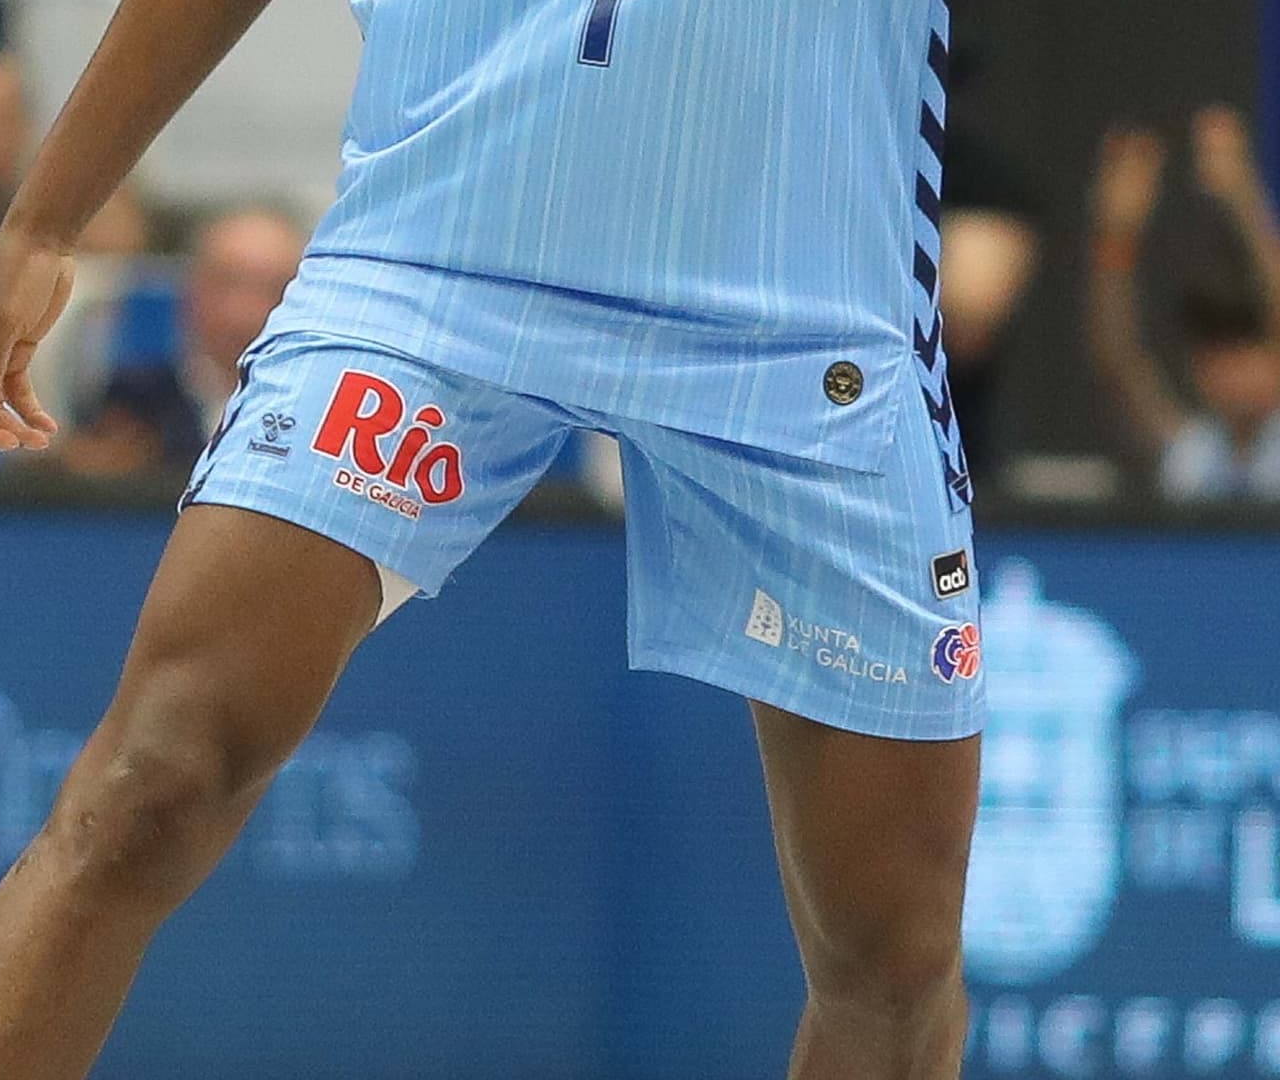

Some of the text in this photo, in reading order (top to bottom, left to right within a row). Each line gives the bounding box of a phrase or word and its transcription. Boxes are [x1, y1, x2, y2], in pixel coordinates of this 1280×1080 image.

[335, 470, 422, 520] DE GALICIA
[938, 562, 968, 592] acb
[786, 612, 861, 654] XUNTA
[786, 633, 908, 685] DE GALICIA
